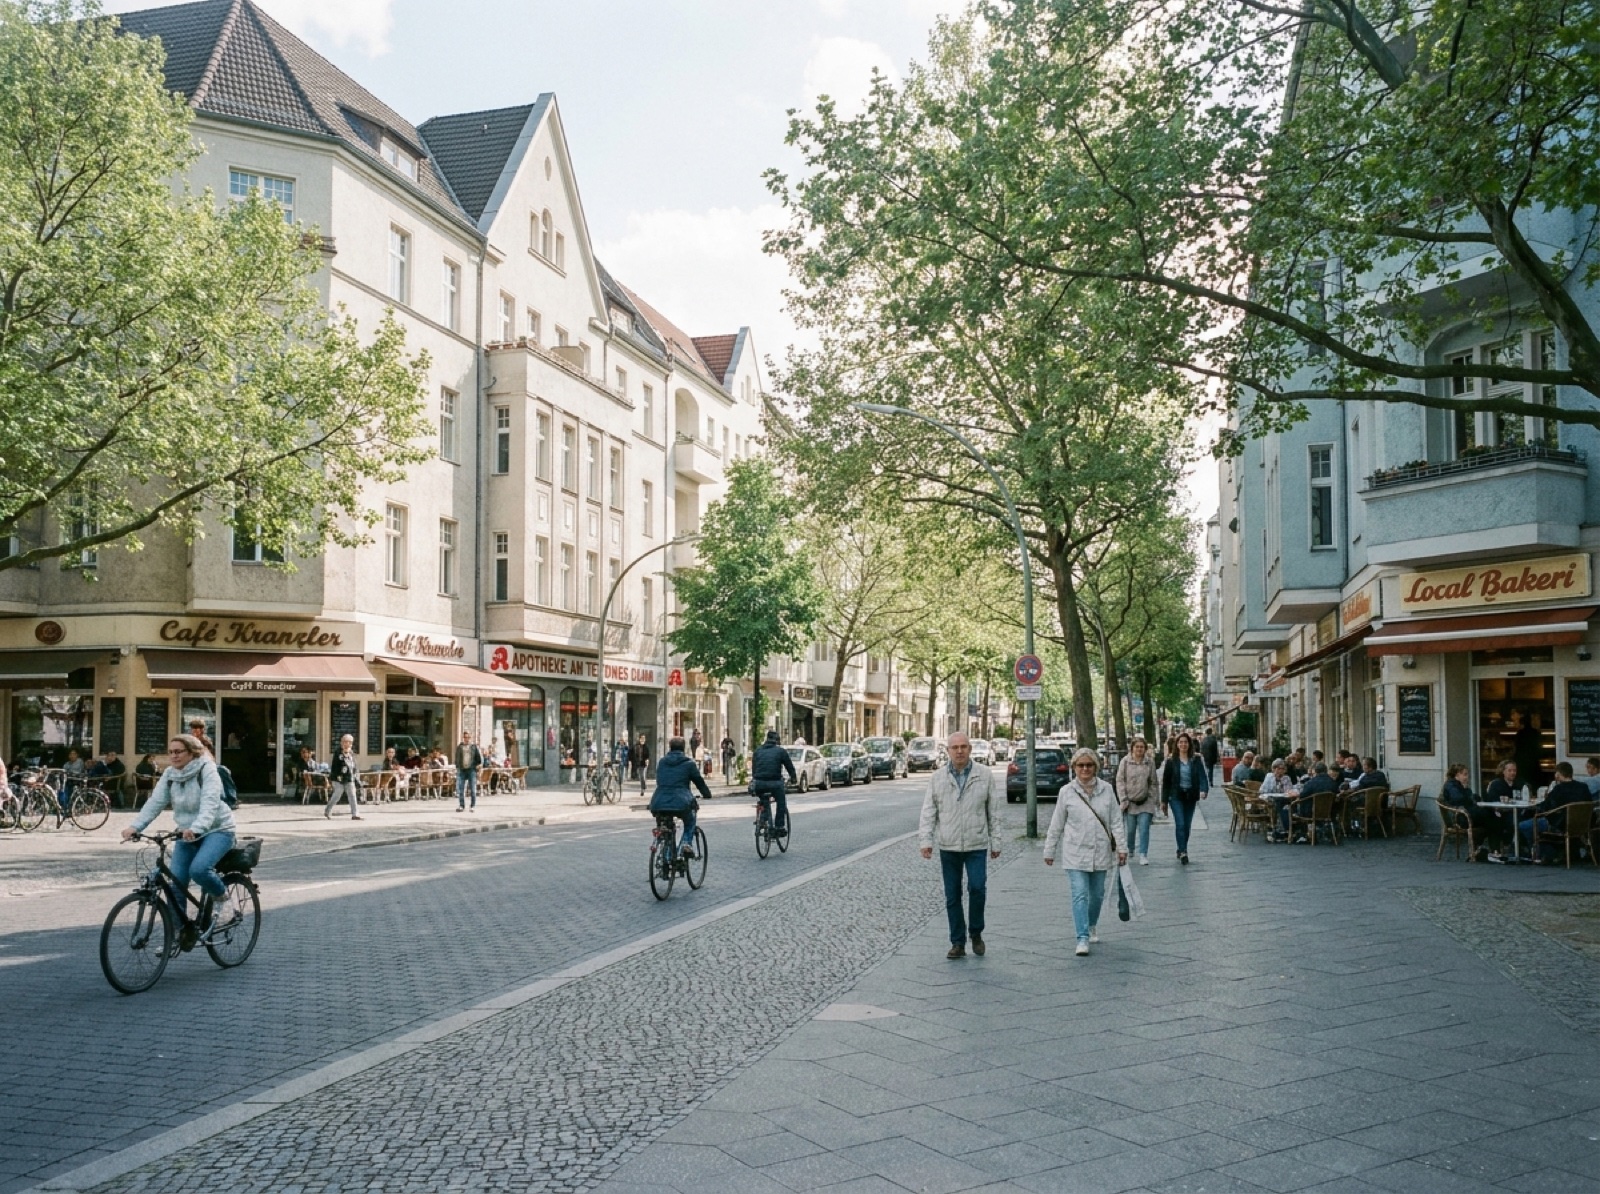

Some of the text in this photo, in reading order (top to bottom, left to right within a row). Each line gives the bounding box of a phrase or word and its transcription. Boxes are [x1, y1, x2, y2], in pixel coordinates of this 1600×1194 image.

[1404, 562, 1577, 603] Local Bakeri
[159, 620, 343, 649] Café Kranzler
